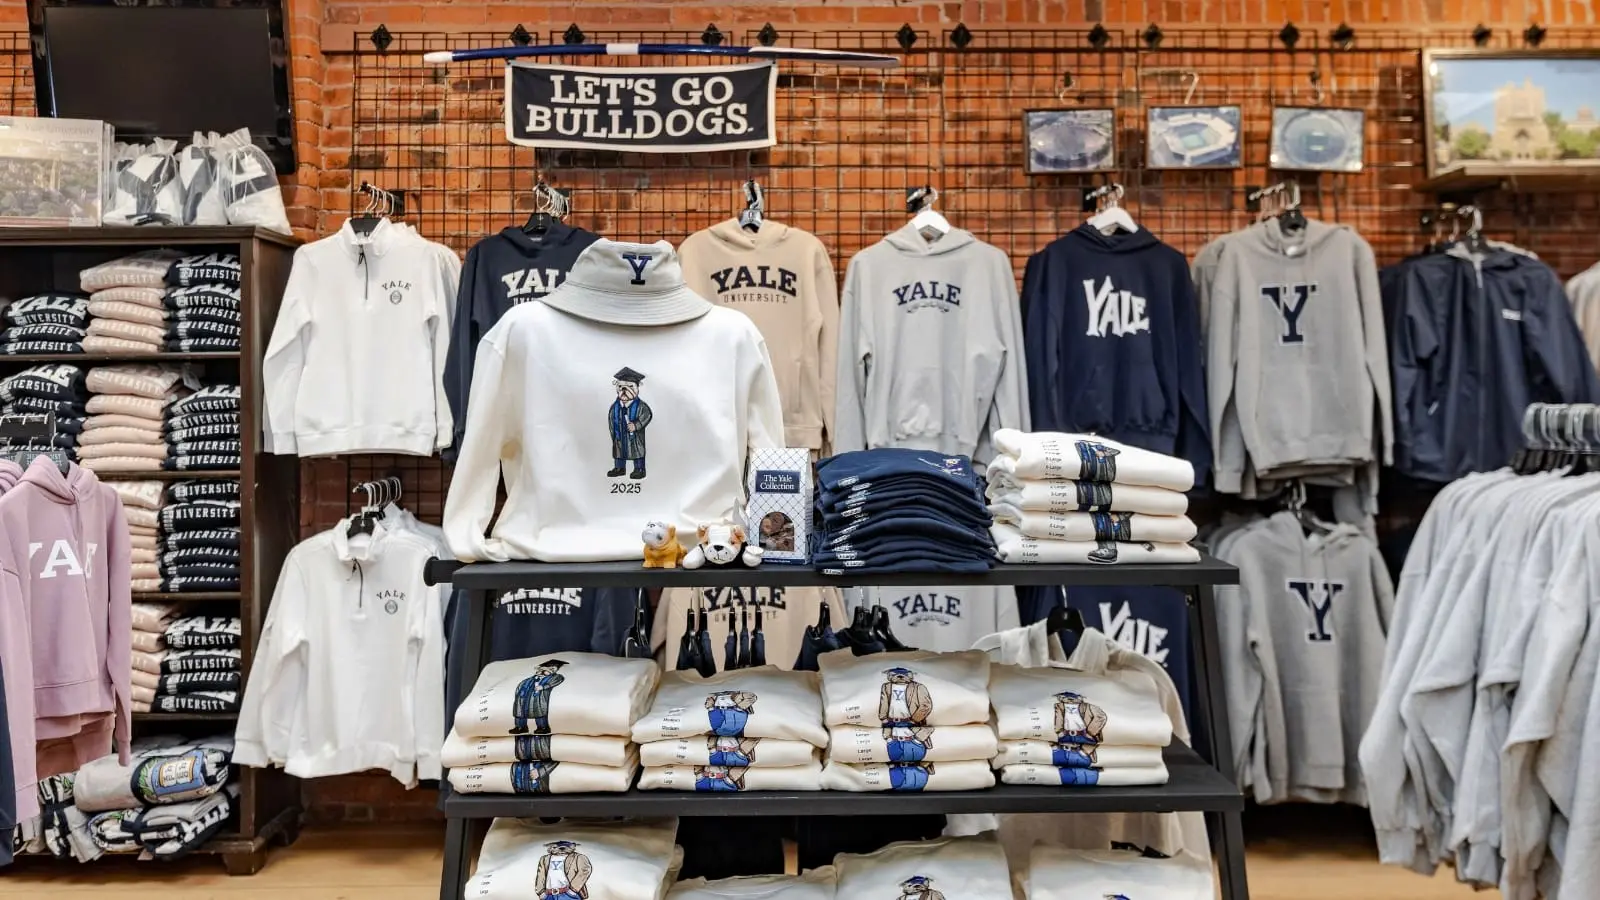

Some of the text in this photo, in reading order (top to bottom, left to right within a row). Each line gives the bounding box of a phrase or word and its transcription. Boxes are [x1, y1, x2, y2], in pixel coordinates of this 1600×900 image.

[550, 74, 734, 106] LET'S GO
[180, 267, 241, 281] NIVERSITY
[622, 253, 652, 285] Y
[381, 280, 412, 291] YALE
[501, 267, 571, 298] YAL
[710, 265, 798, 297] YALE
[723, 293, 788, 304] UNIVERSITY
[892, 281, 961, 306] YALE
[8, 296, 90, 320] YALE
[1083, 275, 1149, 338] YALE
[1261, 283, 1318, 344] Y
[15, 313, 76, 325] NIVERSITY
[178, 307, 241, 321] NIVERSITY
[9, 326, 72, 337] IVERSITY
[172, 399, 238, 414] NIVERSITY
[172, 414, 237, 429] NIVERSITY
[172, 424, 239, 441] NIVERSITY
[764, 474, 792, 482] The Yale
[175, 484, 239, 498] NIVERSITY
[610, 482, 642, 494] 2025
[760, 482, 795, 490] Collection
[168, 530, 236, 541] NIVERSITY
[376, 590, 406, 600] YALE
[507, 603, 571, 615] UNIVERSITY
[892, 592, 961, 619] YALE
[1286, 578, 1344, 645] Y
[1099, 600, 1169, 664] YALE
[167, 634, 234, 647] UIVERSITY
[169, 658, 234, 673] NIVERSITY
[167, 672, 234, 685] IVERSITY
[161, 696, 226, 710] IVERSITY
